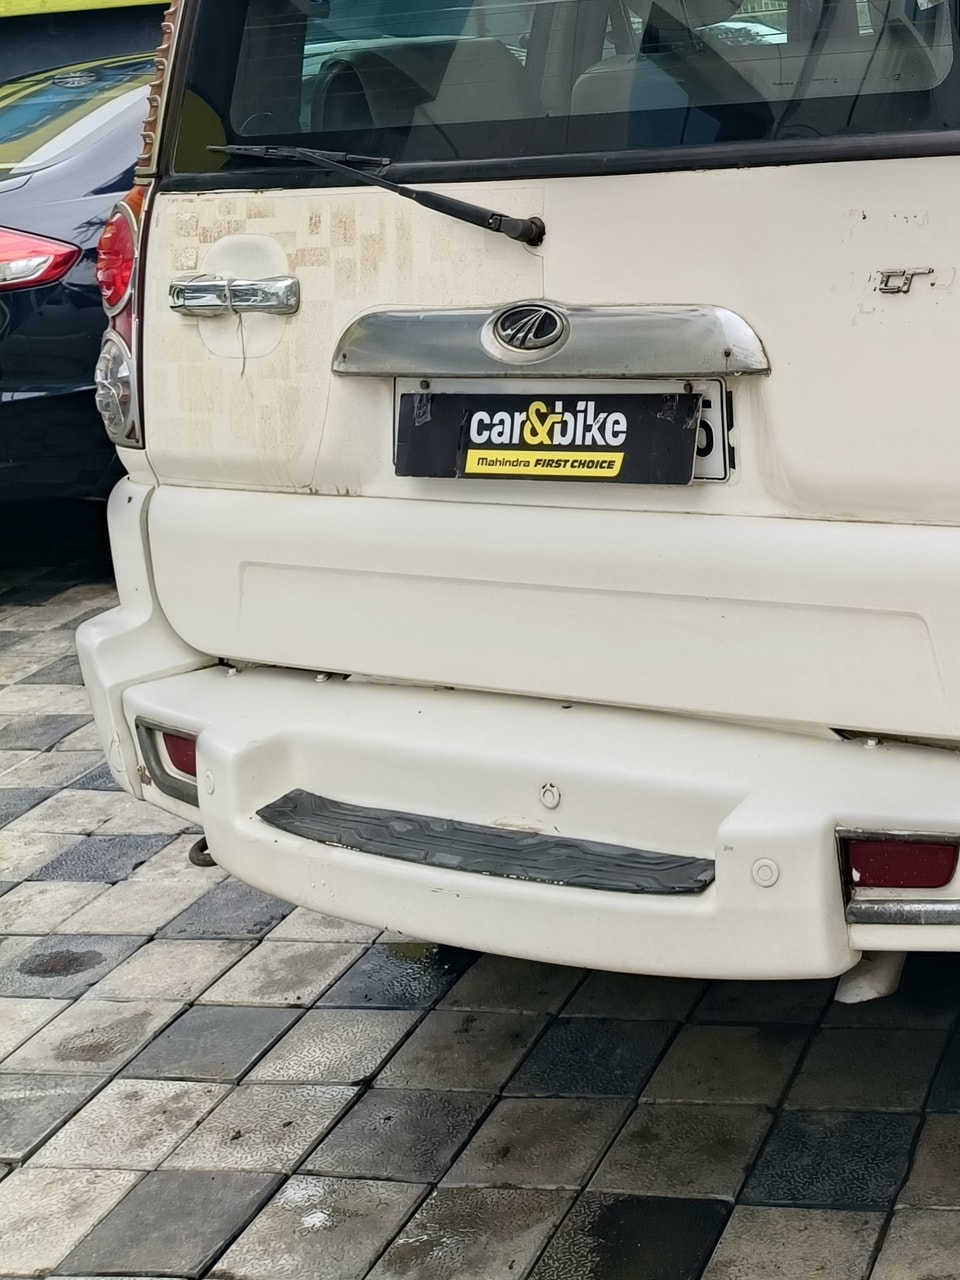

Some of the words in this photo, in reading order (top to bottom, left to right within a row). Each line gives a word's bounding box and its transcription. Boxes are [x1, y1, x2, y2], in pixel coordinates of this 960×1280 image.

[469, 400, 628, 447] car&bike
[477, 457, 531, 468] Mahindra
[533, 459, 569, 469] FIRST
[570, 460, 616, 470] CHOICE
